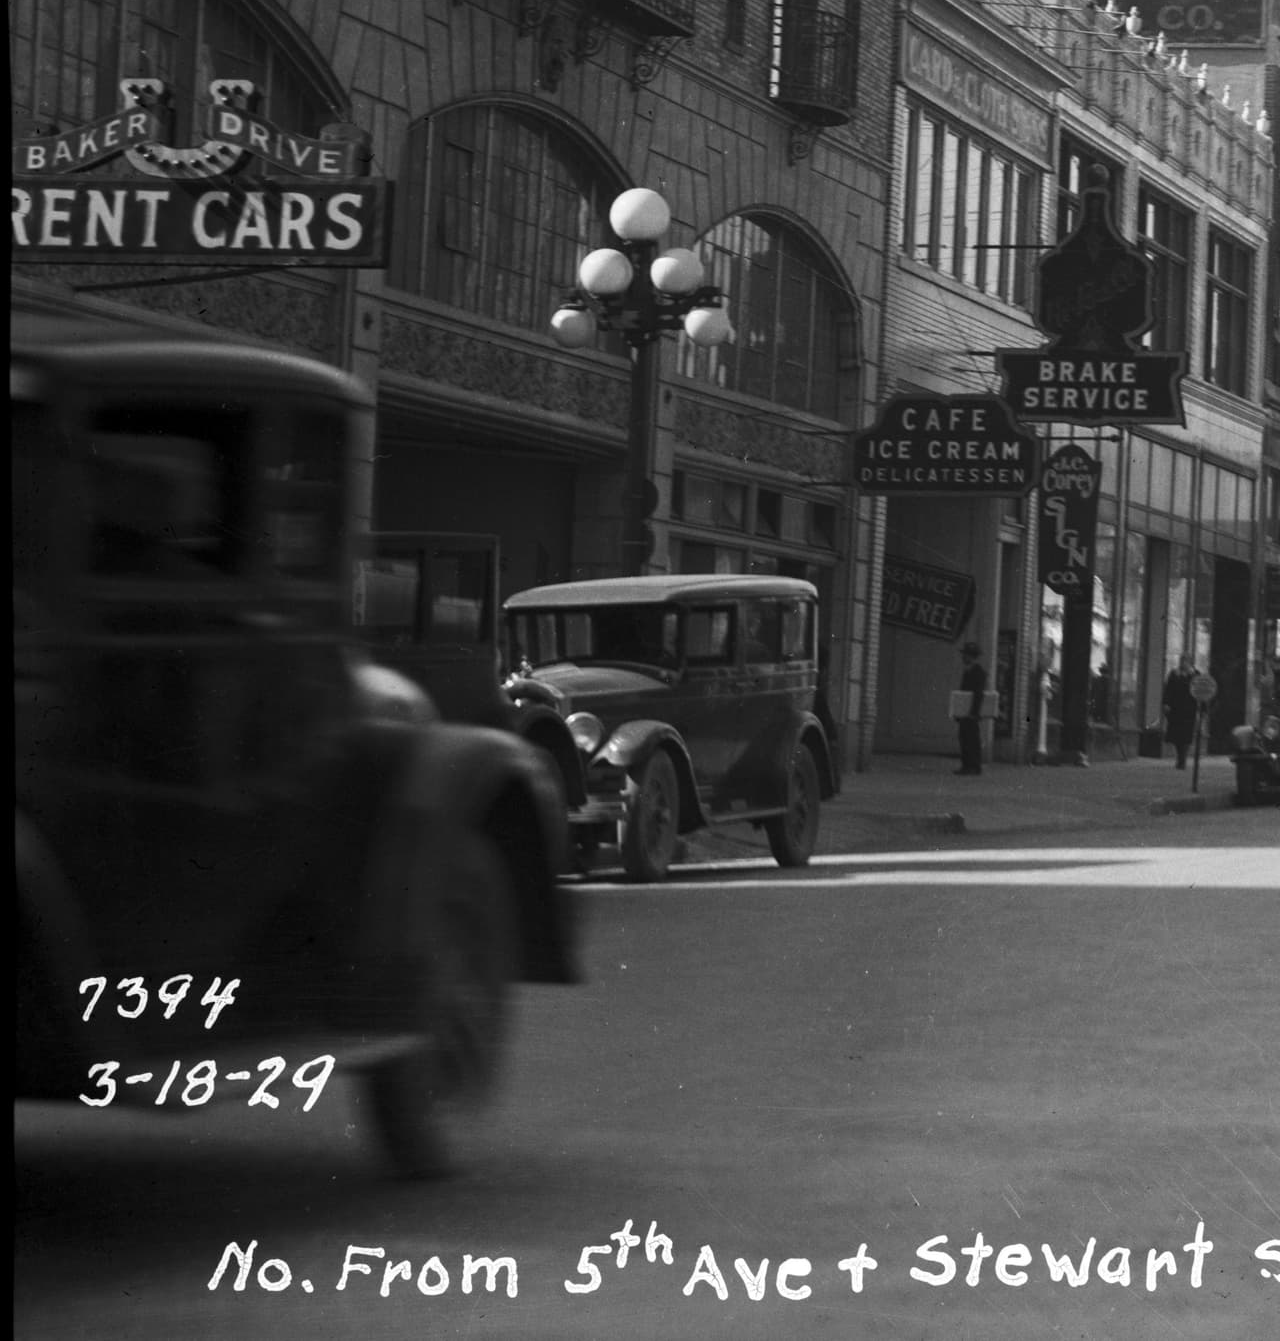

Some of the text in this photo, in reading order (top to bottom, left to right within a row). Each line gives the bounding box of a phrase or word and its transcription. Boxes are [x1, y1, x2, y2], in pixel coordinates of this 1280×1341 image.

[1157, 4, 1225, 31] CO.
[26, 112, 147, 171] BAKER
[220, 111, 343, 174] DRIVE
[10, 187, 364, 251] RENT CARS
[1039, 361, 1137, 384] BRAKE
[1024, 388, 1149, 411] SERVICE
[902, 408, 987, 432] CAFE
[868, 440, 1021, 460] ICE CREAM
[860, 466, 1026, 484] DELICATESSEN
[1042, 468, 1098, 499] Corey
[1043, 496, 1089, 568] SIGN
[884, 565, 959, 597] SERVICE
[902, 595, 959, 632] FREE
